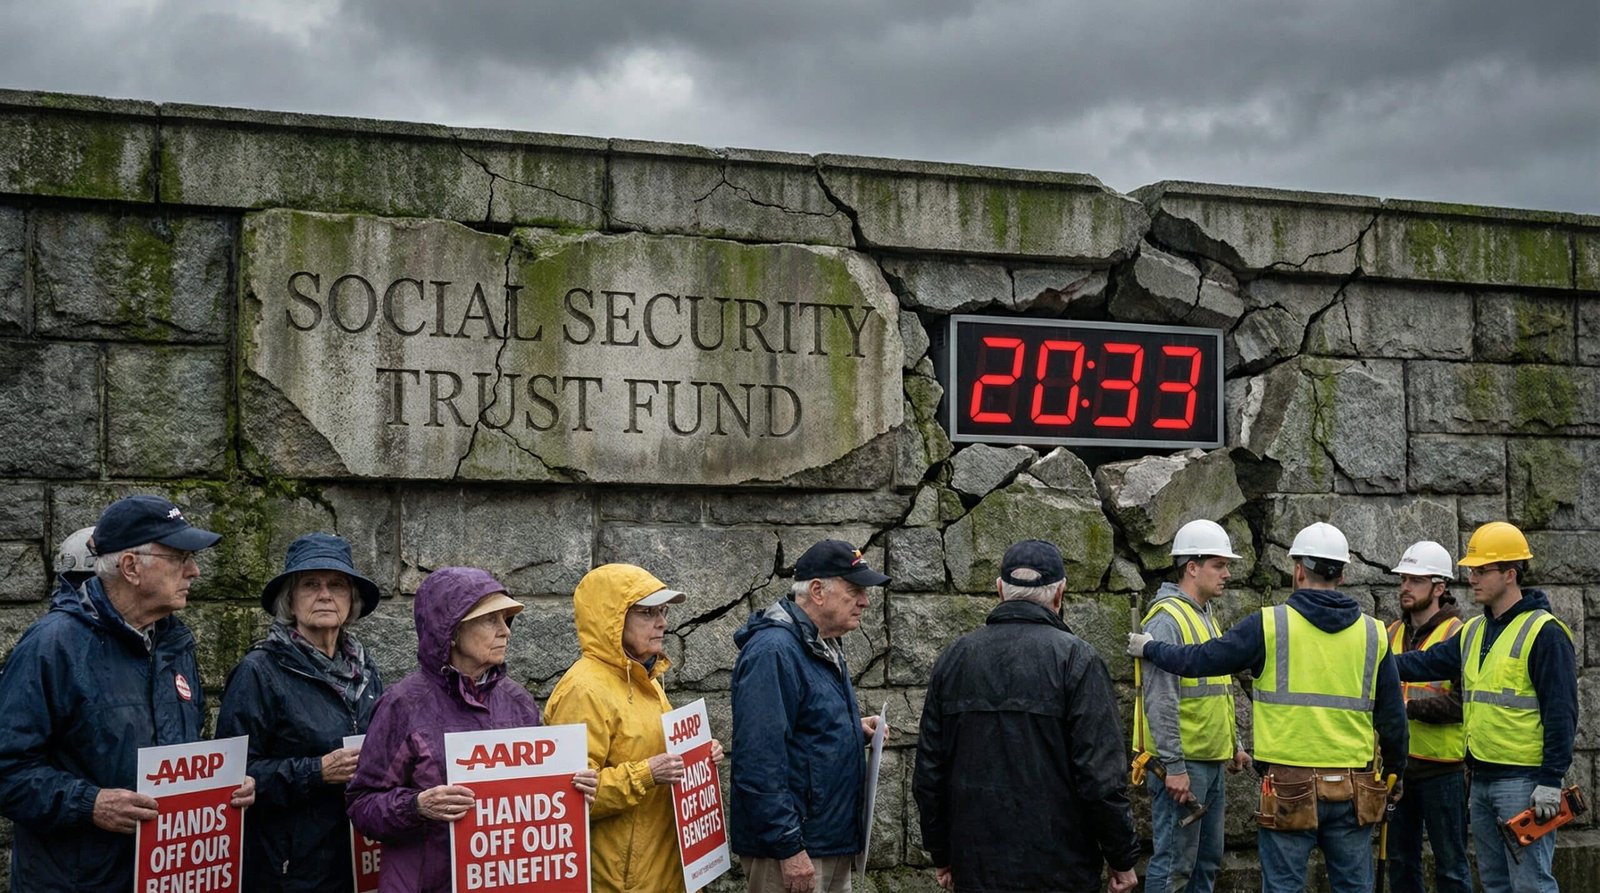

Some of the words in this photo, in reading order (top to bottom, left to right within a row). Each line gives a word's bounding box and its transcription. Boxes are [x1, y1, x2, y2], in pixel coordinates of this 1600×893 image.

[286, 271, 543, 342] SOCIAL
[562, 287, 873, 358] SECURITY
[970, 337, 1202, 429] 20:33
[376, 367, 603, 432] TRUST
[623, 378, 801, 439] FUND
[669, 714, 701, 746] AARP
[146, 752, 225, 785] AARP
[456, 739, 556, 770] AARP
[681, 757, 712, 794] HANDS
[475, 790, 567, 827] HANDS
[681, 793, 698, 821] OFF
[699, 784, 718, 812] OUR
[157, 803, 227, 842] HANDS
[470, 828, 516, 858] OFF
[522, 823, 574, 853] OUR
[682, 808, 722, 849] BENEFITS
[150, 842, 187, 873] OFF
[190, 834, 231, 865] OUR
[466, 851, 579, 890] BENEFITS
[146, 862, 233, 893] BENEFITS
